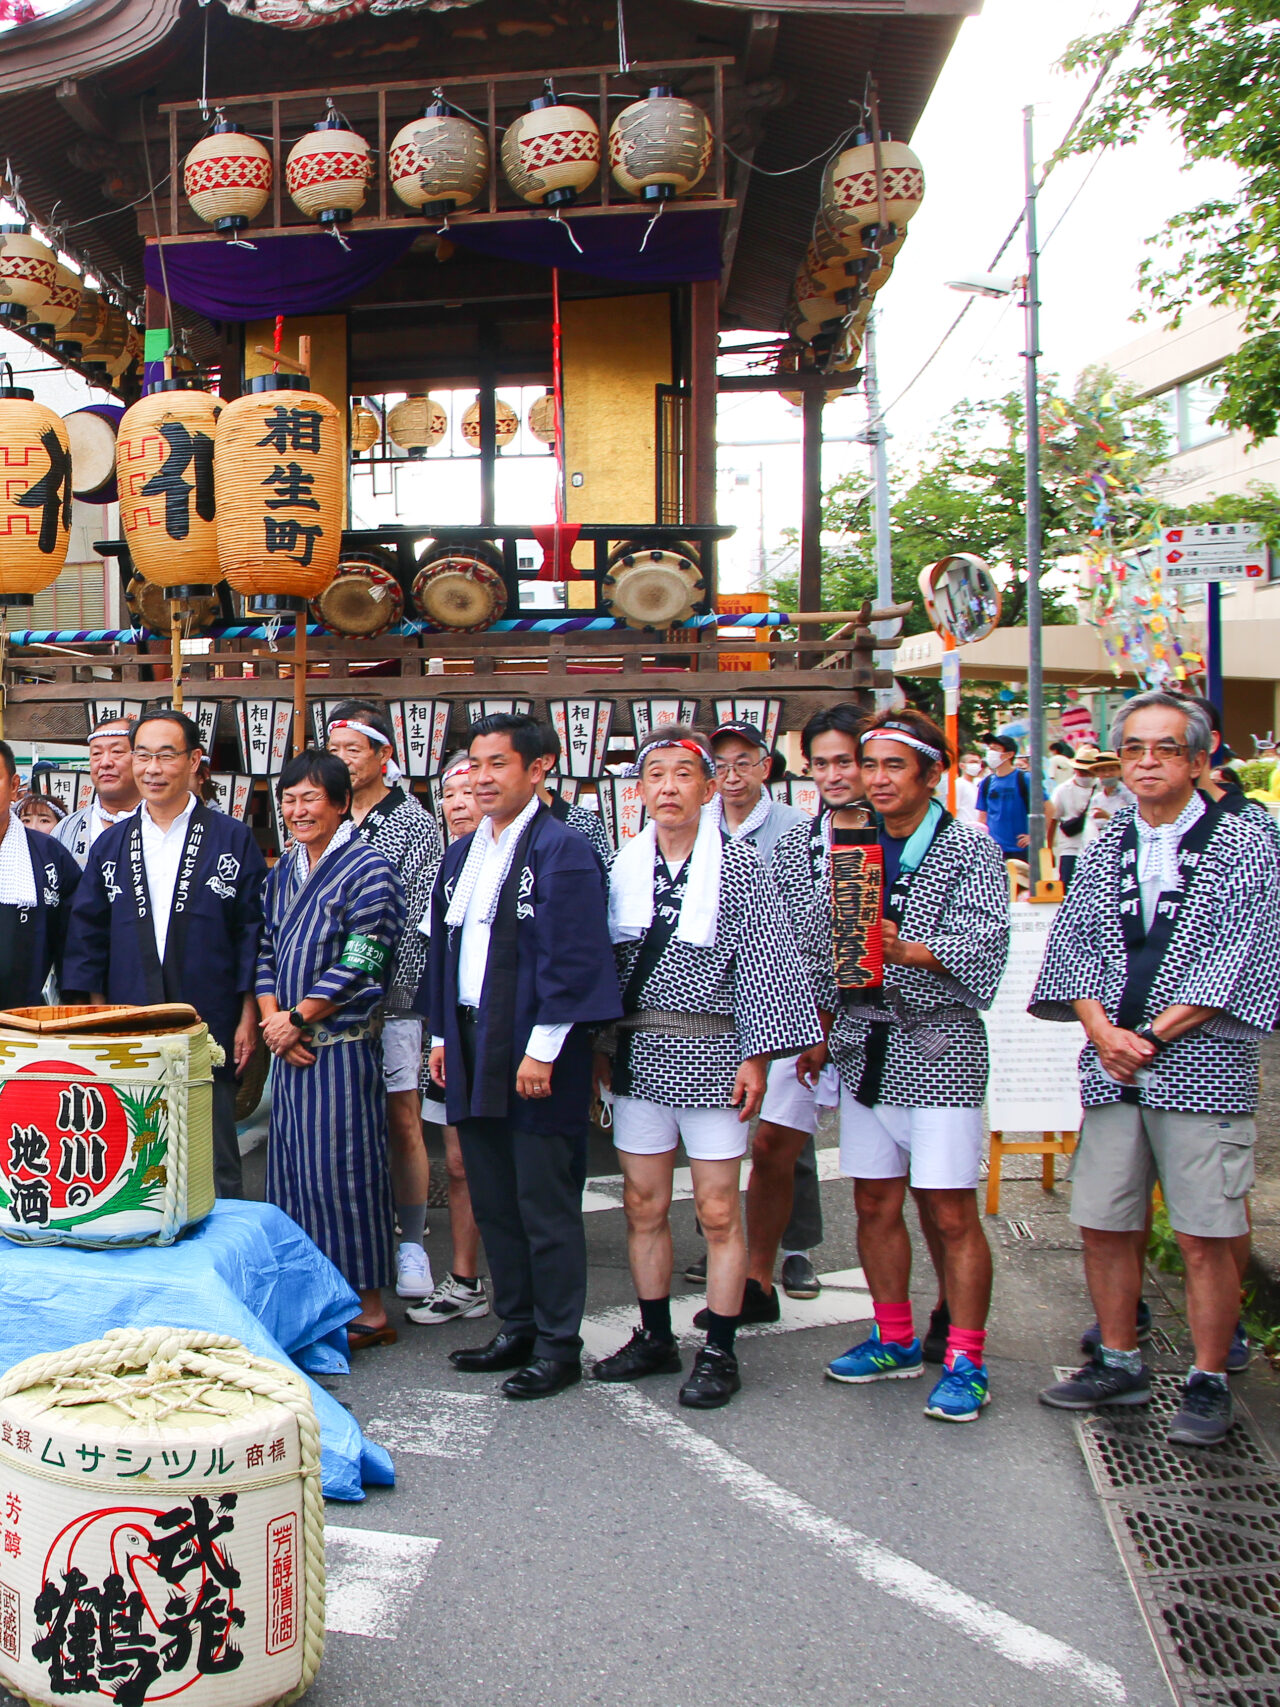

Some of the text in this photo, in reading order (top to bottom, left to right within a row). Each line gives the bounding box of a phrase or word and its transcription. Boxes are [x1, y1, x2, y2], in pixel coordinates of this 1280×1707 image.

[256, 405, 324, 567] 相生町
[250, 704, 268, 756] 相生町
[408, 704, 427, 758] 相生町
[571, 704, 590, 756] 相生町
[637, 707, 649, 741] 相生
[232, 785, 247, 817] 御祭
[358, 810, 386, 844] 相生
[130, 828, 147, 918] 小川町七夕まつり
[175, 822, 205, 913] 小川町七夕まつり
[890, 873, 911, 912] 生町
[1119, 848, 1141, 916] 相生町
[56, 1083, 108, 1208] 小川の
[8, 1124, 52, 1228] 地酒
[41, 1437, 235, 1479] ムサシツル
[246, 1437, 288, 1470] 商標
[4, 1490, 23, 1561] 芳醇
